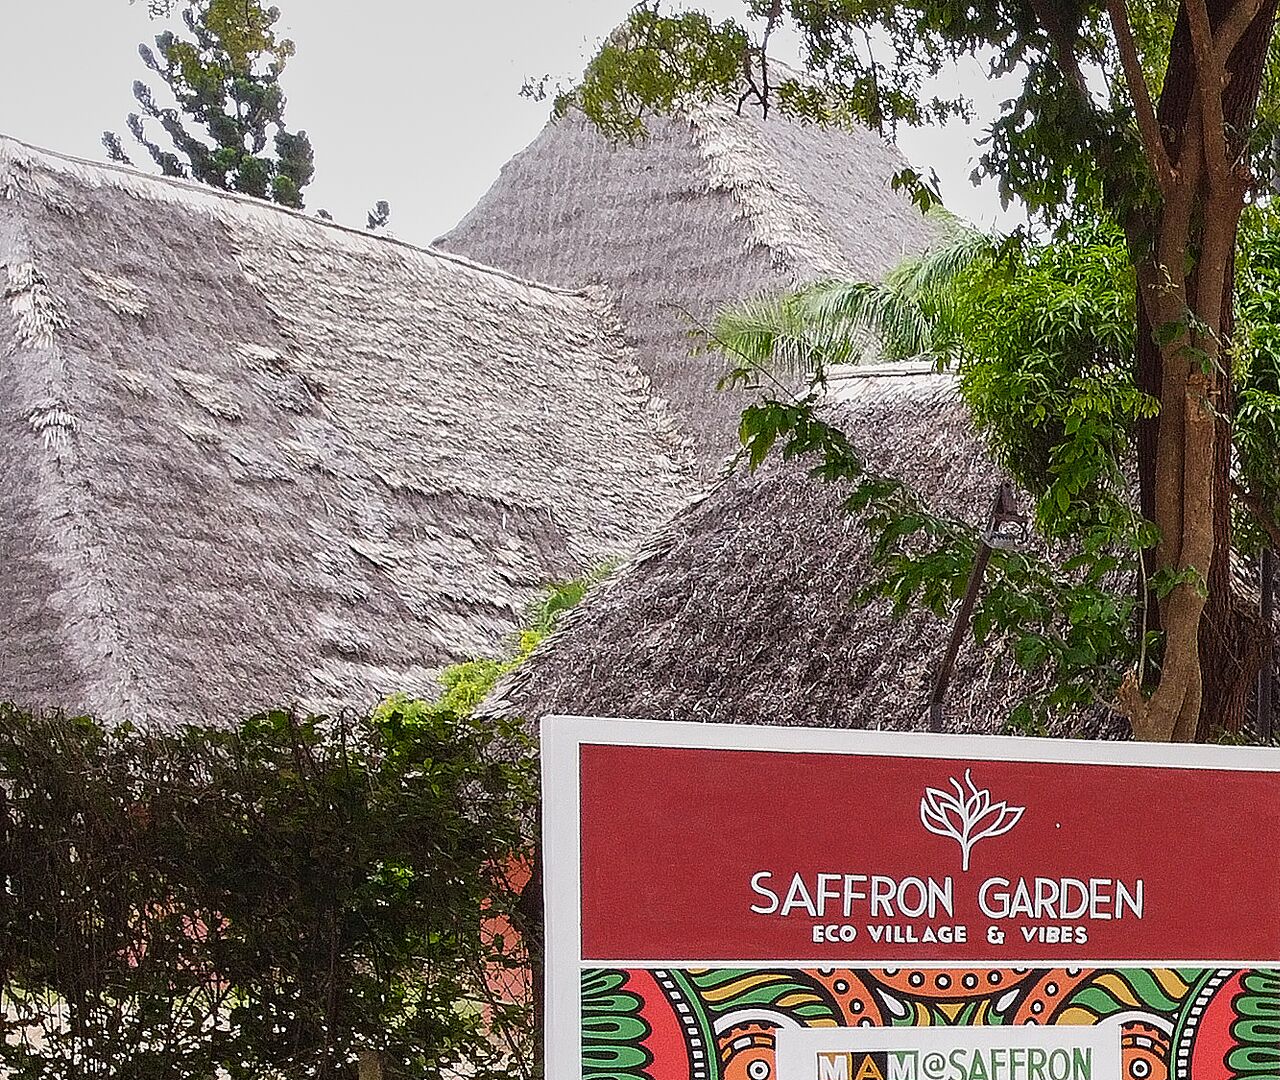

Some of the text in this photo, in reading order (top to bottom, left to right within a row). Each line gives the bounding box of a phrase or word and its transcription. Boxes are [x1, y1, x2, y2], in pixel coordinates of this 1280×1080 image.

[750, 871, 1144, 920] SAFFRON GARDEN
[812, 925, 1089, 944] ECO VILLAGE & VIBES
